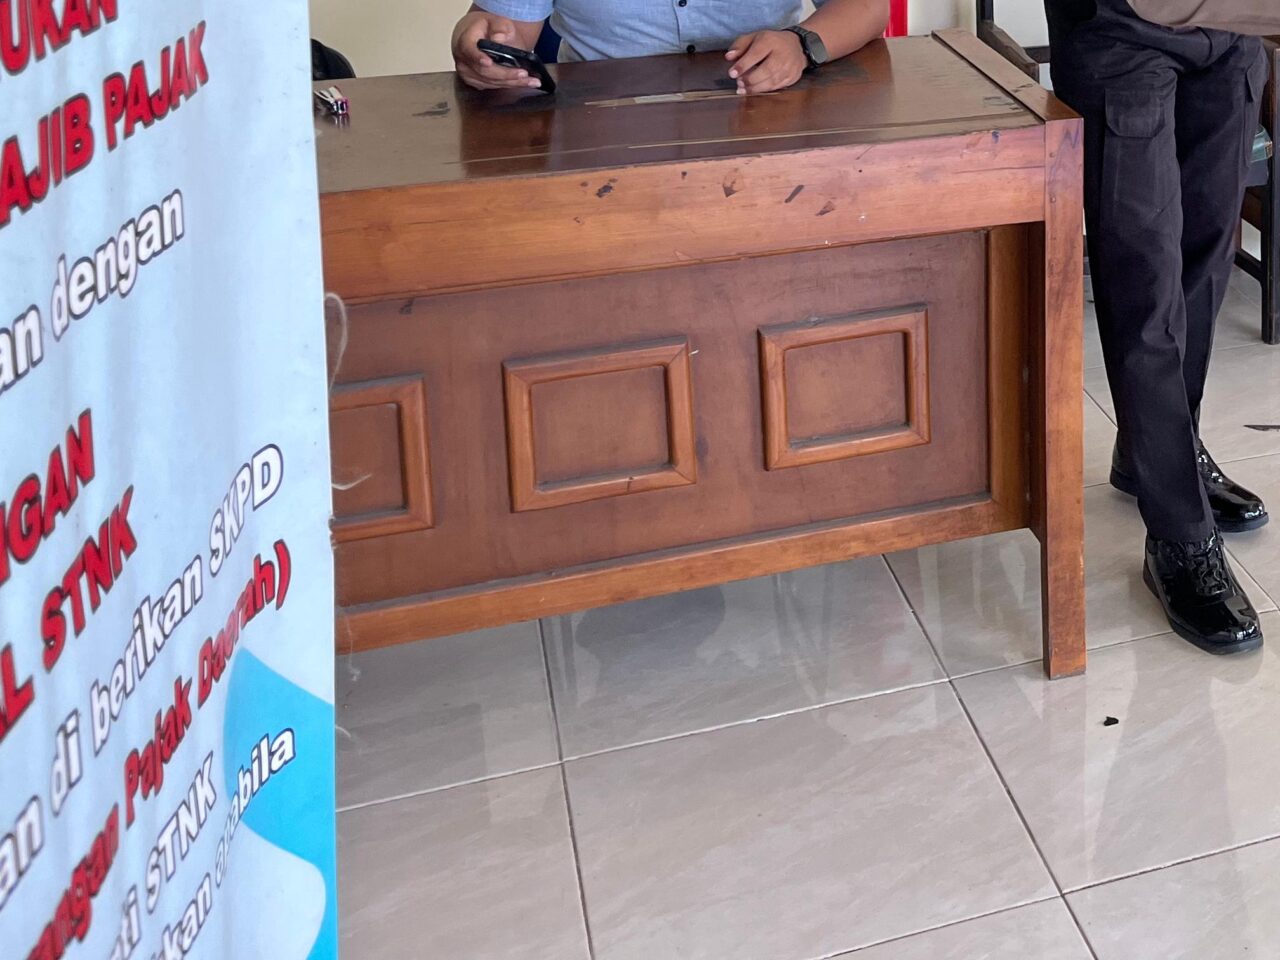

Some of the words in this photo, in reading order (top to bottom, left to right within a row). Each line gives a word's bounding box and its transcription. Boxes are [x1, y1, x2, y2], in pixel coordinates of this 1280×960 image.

[103, 20, 209, 152] PAJAK
[51, 189, 185, 342] dengan
[41, 485, 137, 673] STNK
[51, 708, 83, 818] di
[90, 554, 203, 757] berikan
[209, 443, 285, 578] SKPD
[124, 671, 193, 830] Pajak
[199, 539, 292, 708] Daerah)
[146, 750, 217, 915] STNK
[215, 728, 297, 888] apabila
